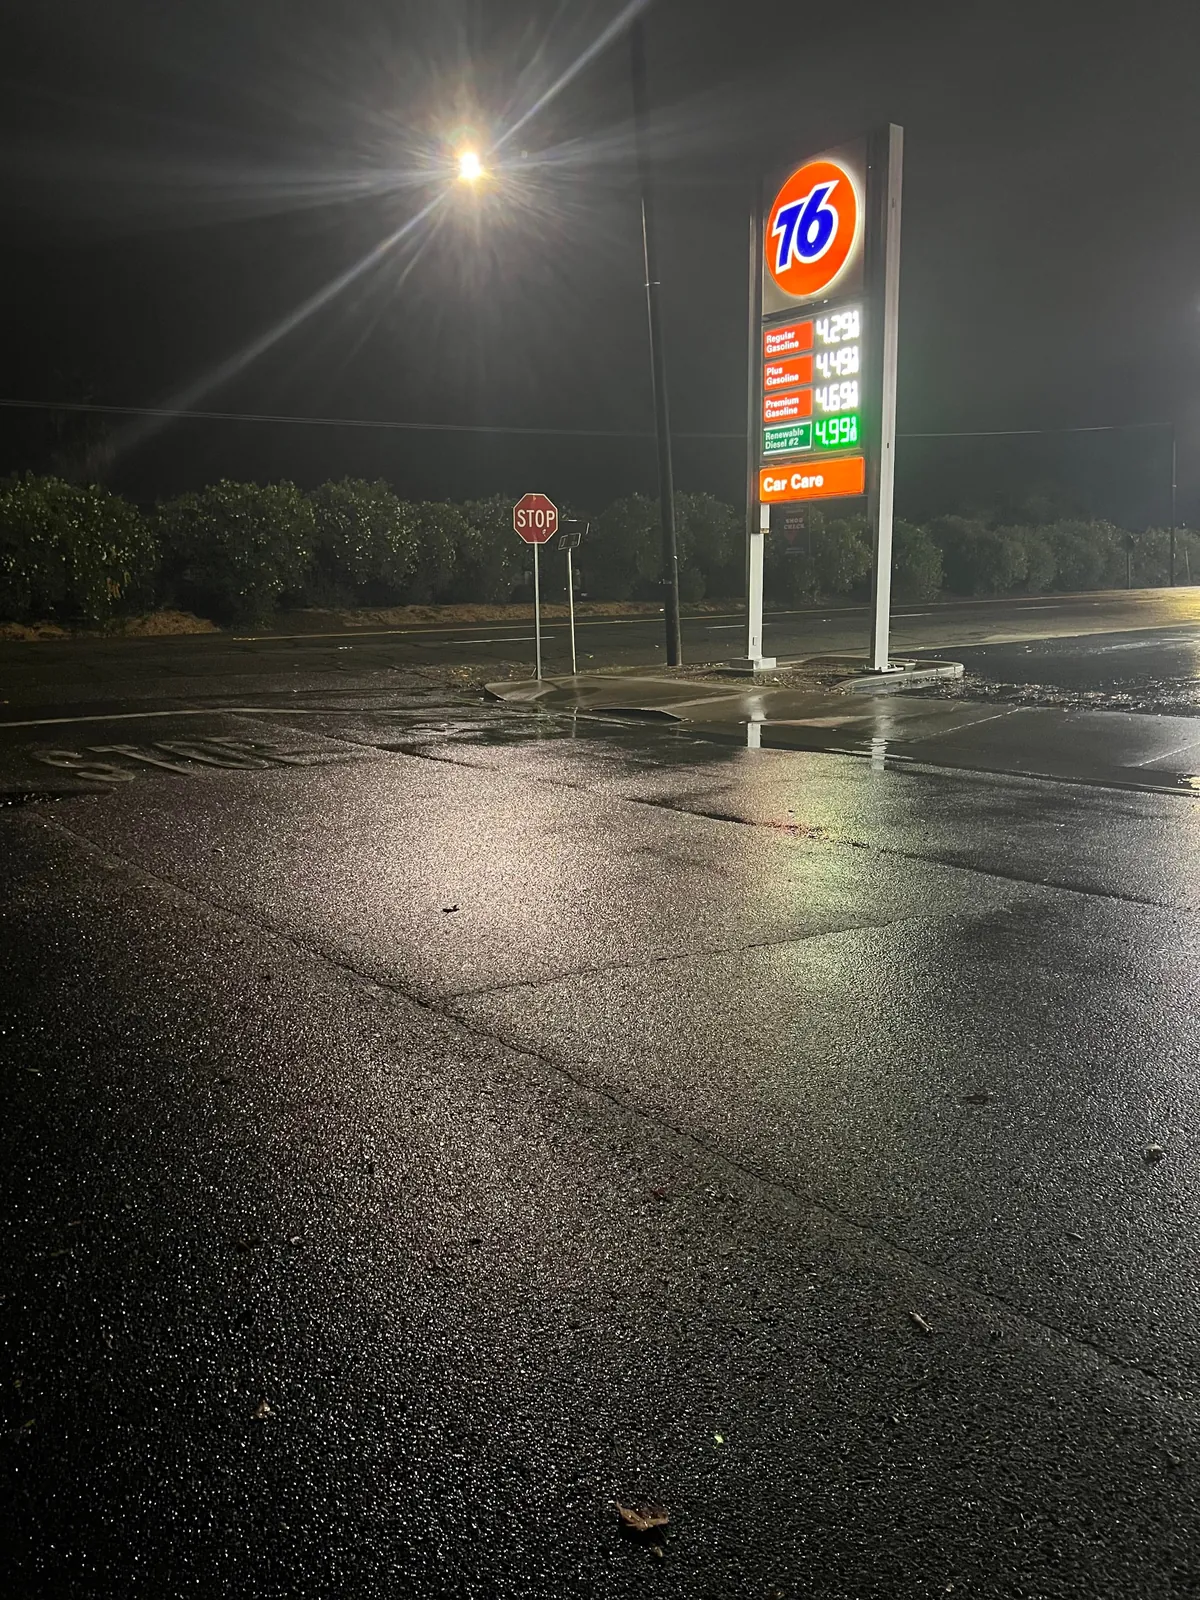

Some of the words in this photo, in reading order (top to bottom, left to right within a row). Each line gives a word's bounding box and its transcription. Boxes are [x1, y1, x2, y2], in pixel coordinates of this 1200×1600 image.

[771, 180, 839, 275] 76
[766, 331, 796, 344] Regular
[766, 341, 800, 354] Gasoline
[766, 367, 783, 377] Plus
[766, 374, 800, 386] Gasoline
[765, 397, 800, 409] Premium
[765, 407, 798, 419] Gasoline
[765, 428, 804, 441] Renewable
[765, 439, 787, 450] Diesel
[788, 437, 799, 447] #2
[763, 477, 788, 493] Car
[790, 473, 824, 490] Care
[517, 509, 556, 528] STOP
